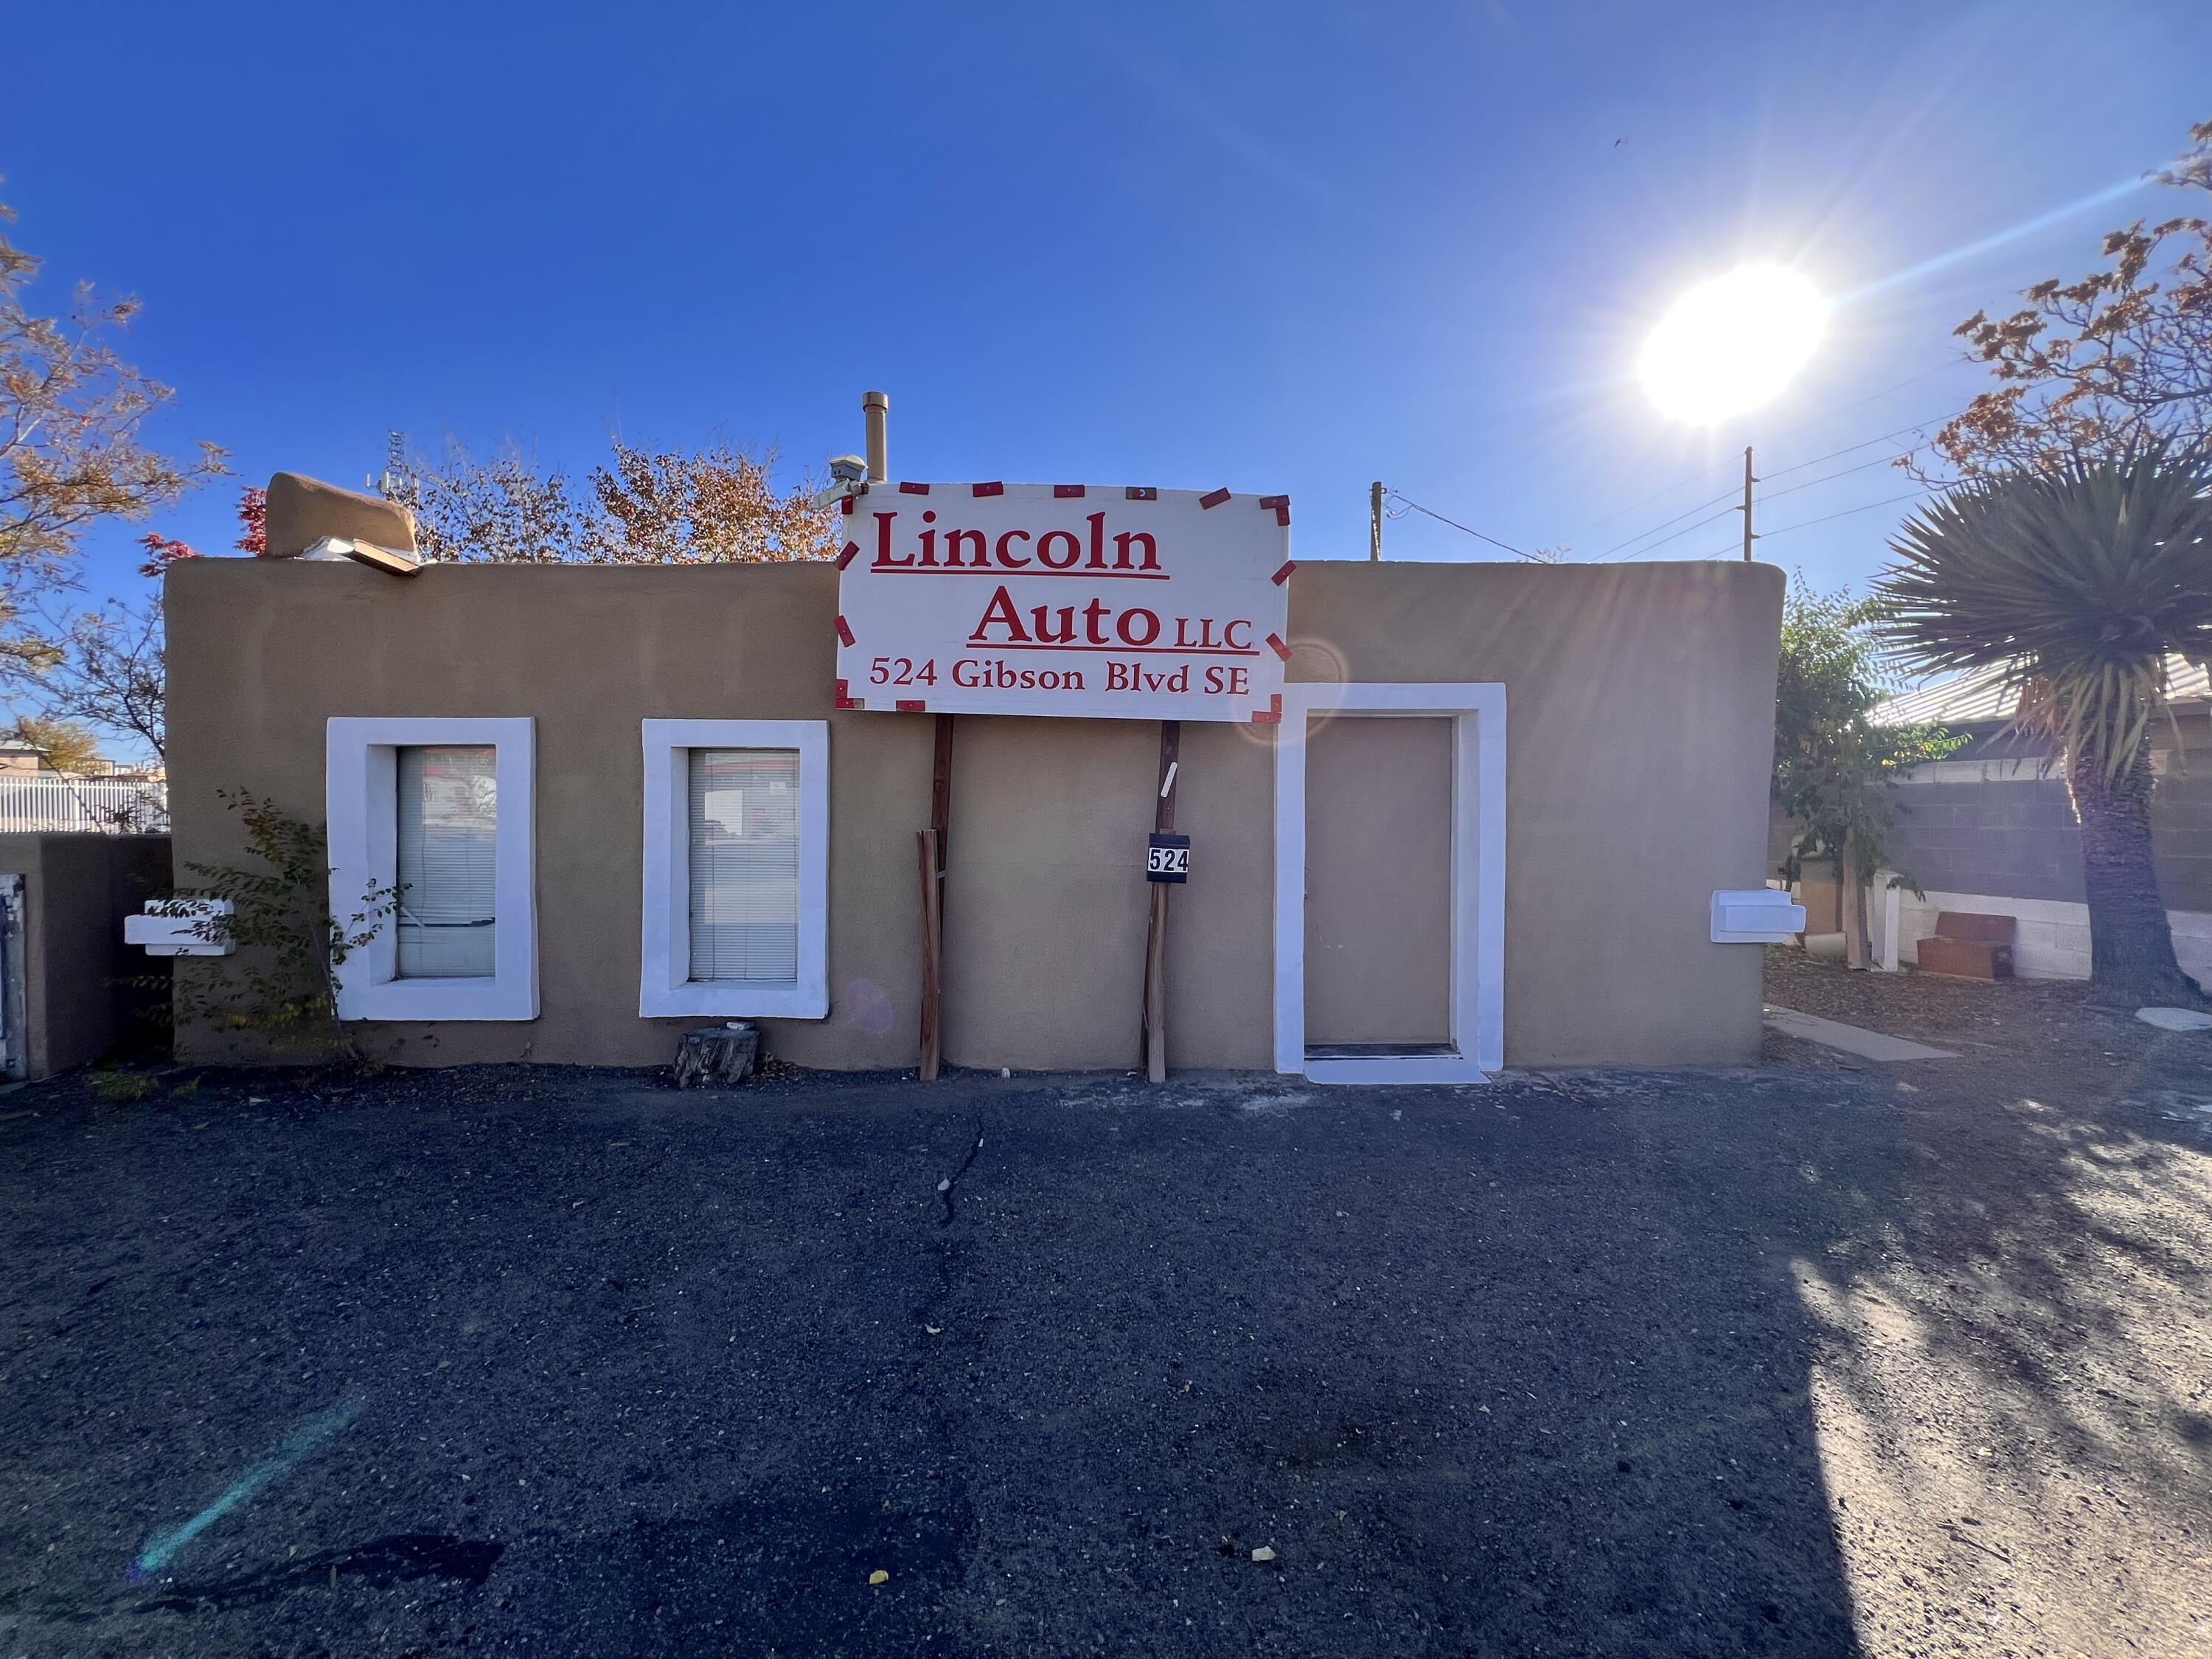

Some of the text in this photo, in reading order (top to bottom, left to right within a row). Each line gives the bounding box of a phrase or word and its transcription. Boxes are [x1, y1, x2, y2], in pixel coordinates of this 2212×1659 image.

[872, 511, 1161, 571] Lincoln
[968, 585, 1253, 650] Auto LLC
[870, 657, 1250, 696] 524 Gibson Blvd SE
[1150, 849, 1188, 872] 524
